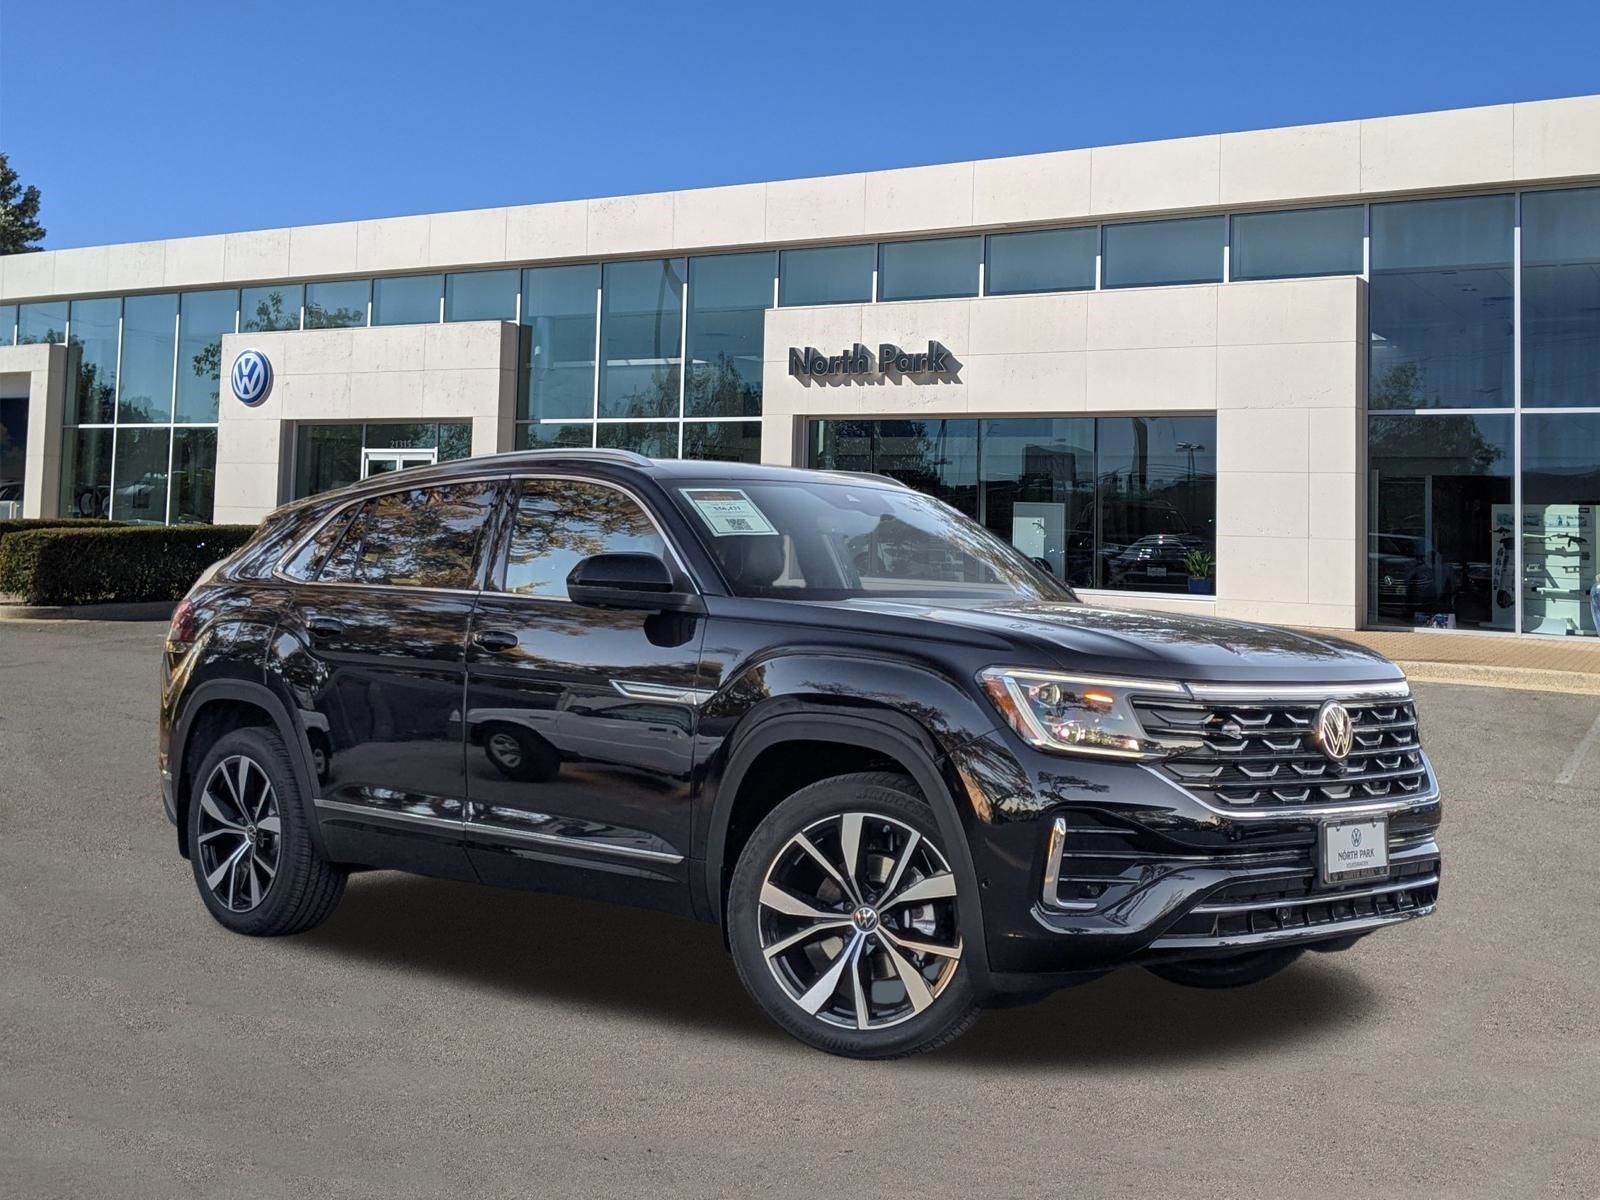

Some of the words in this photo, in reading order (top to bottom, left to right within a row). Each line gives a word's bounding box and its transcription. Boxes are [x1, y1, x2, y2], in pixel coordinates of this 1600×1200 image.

[232, 351, 267, 401] VW
[789, 343, 873, 375] North
[878, 340, 947, 373] Park
[1321, 702, 1351, 758] VW
[1338, 850, 1359, 861] NORTH
[1360, 848, 1375, 859] PARK
